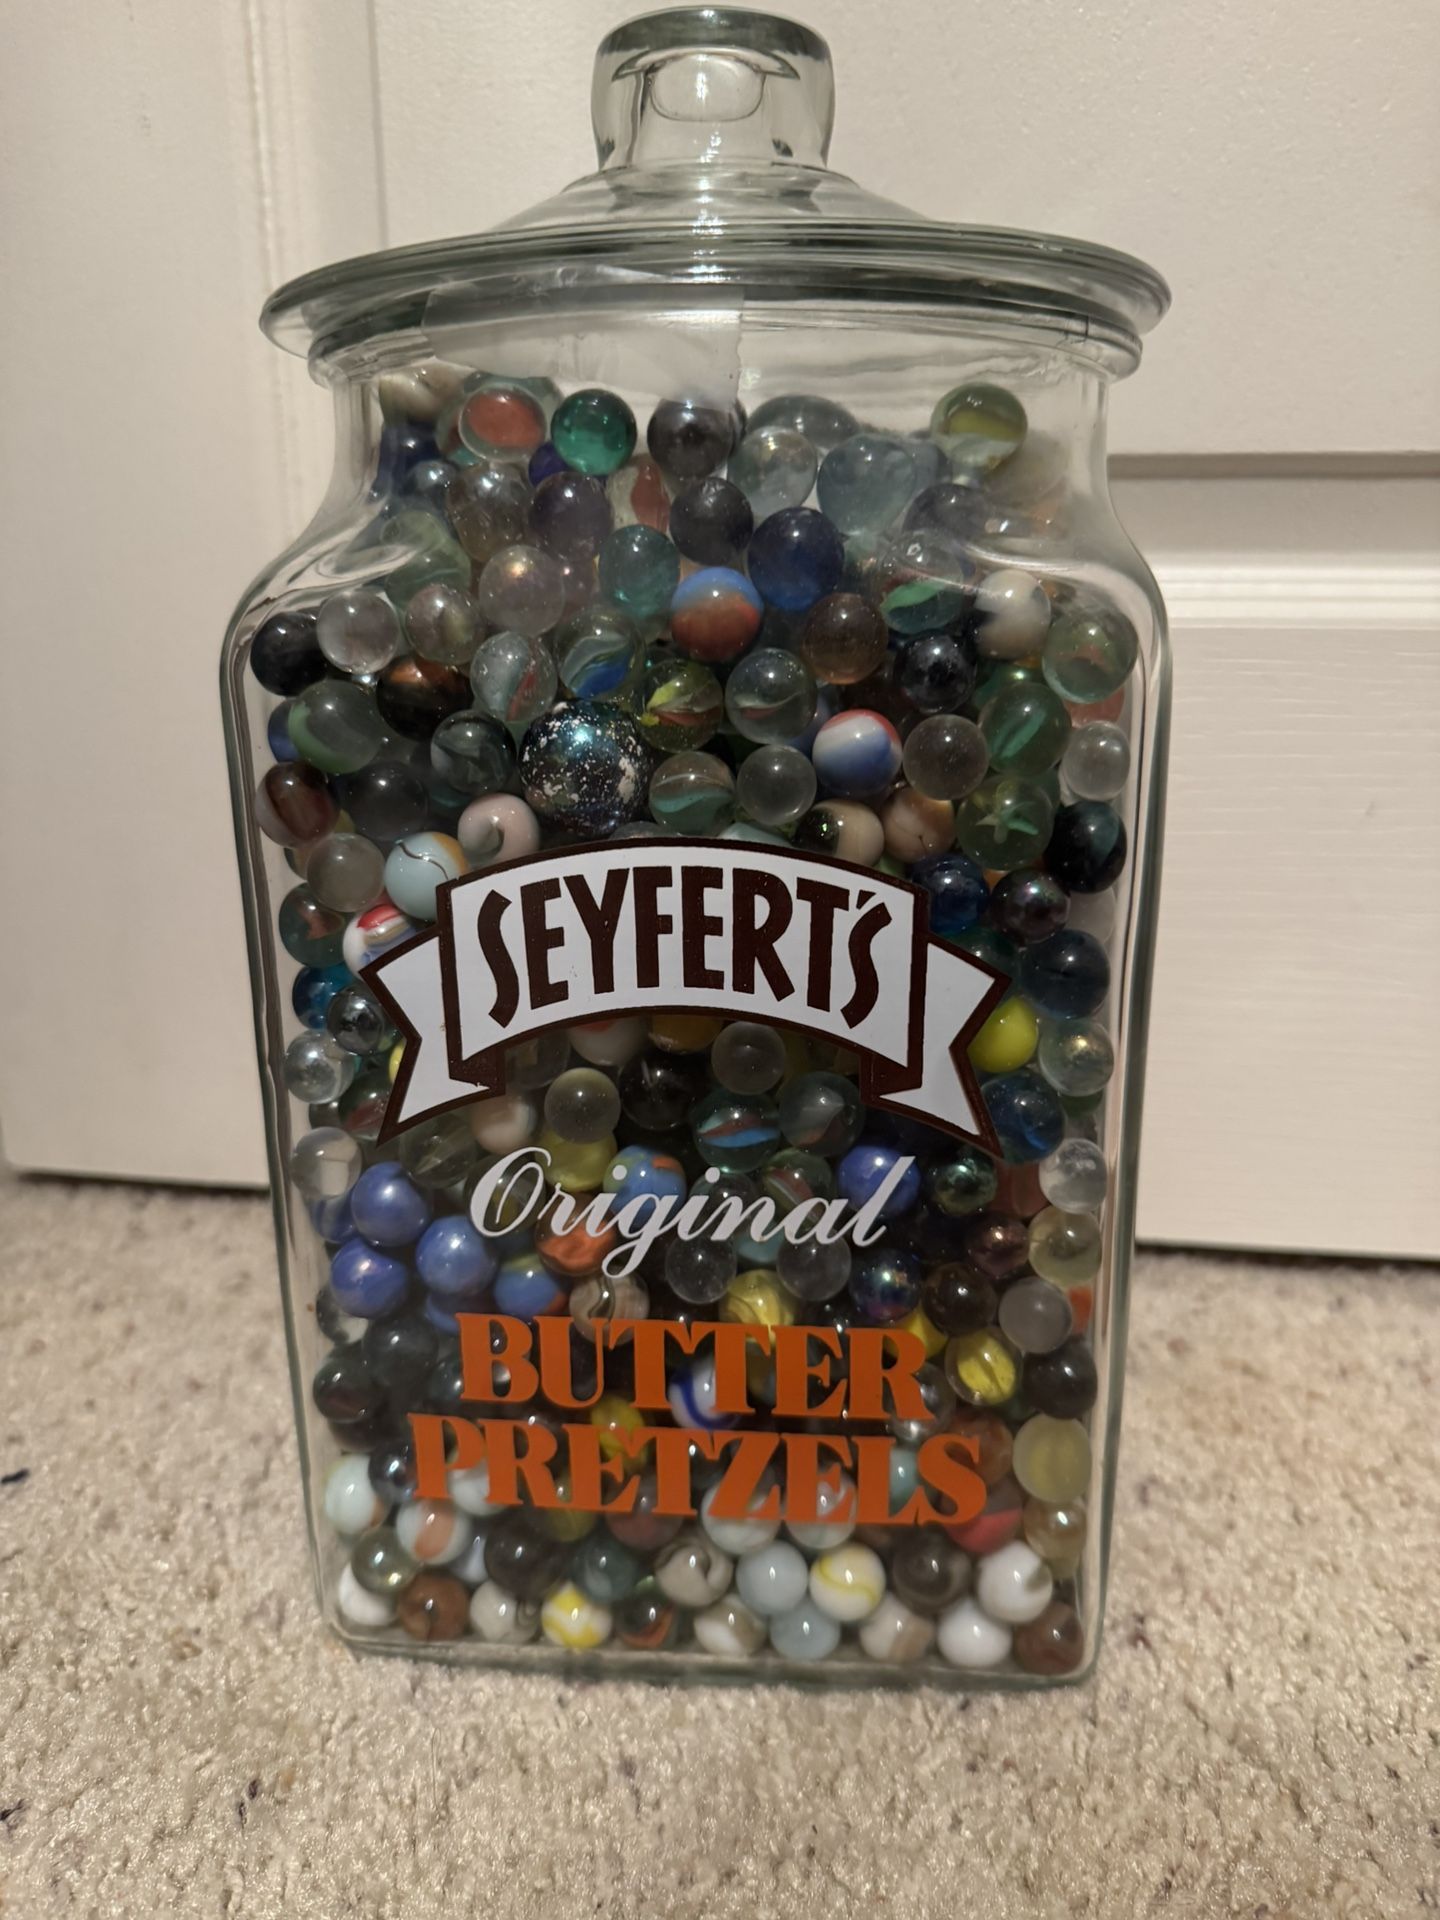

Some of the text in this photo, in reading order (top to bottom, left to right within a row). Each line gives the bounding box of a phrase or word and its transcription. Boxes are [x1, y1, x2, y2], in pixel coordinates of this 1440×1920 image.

[476, 865, 892, 1029] SEYFERT'S
[470, 1146, 915, 1279] Original
[455, 1312, 935, 1420] BUTTER
[407, 1412, 987, 1525] PRETZELS
